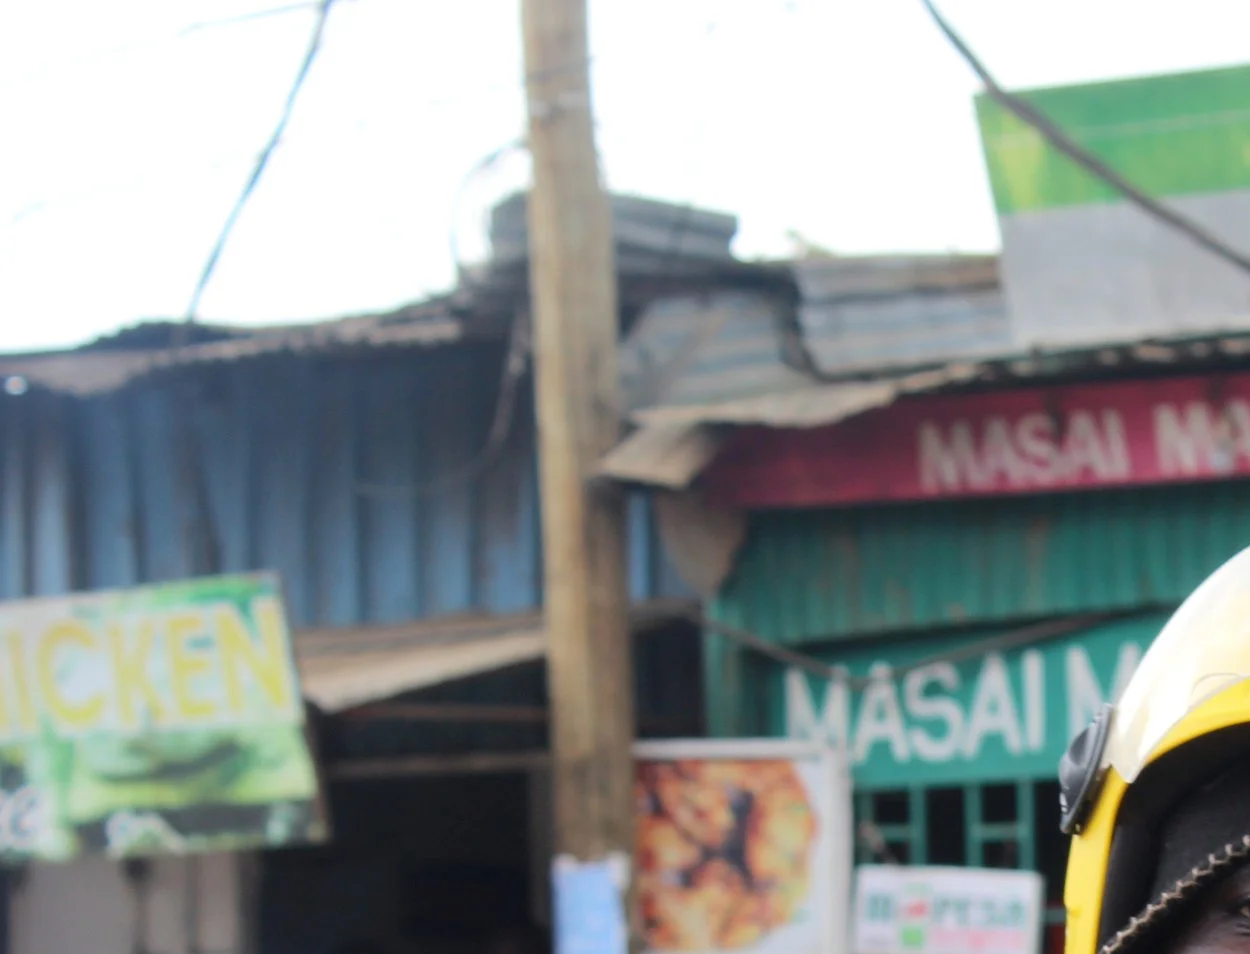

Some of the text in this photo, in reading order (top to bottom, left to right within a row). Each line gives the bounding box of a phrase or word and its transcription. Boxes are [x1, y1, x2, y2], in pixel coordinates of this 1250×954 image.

[917, 406, 1131, 493] MASAI
[0, 602, 286, 732] ICKEN
[784, 646, 1046, 762] MASAI
